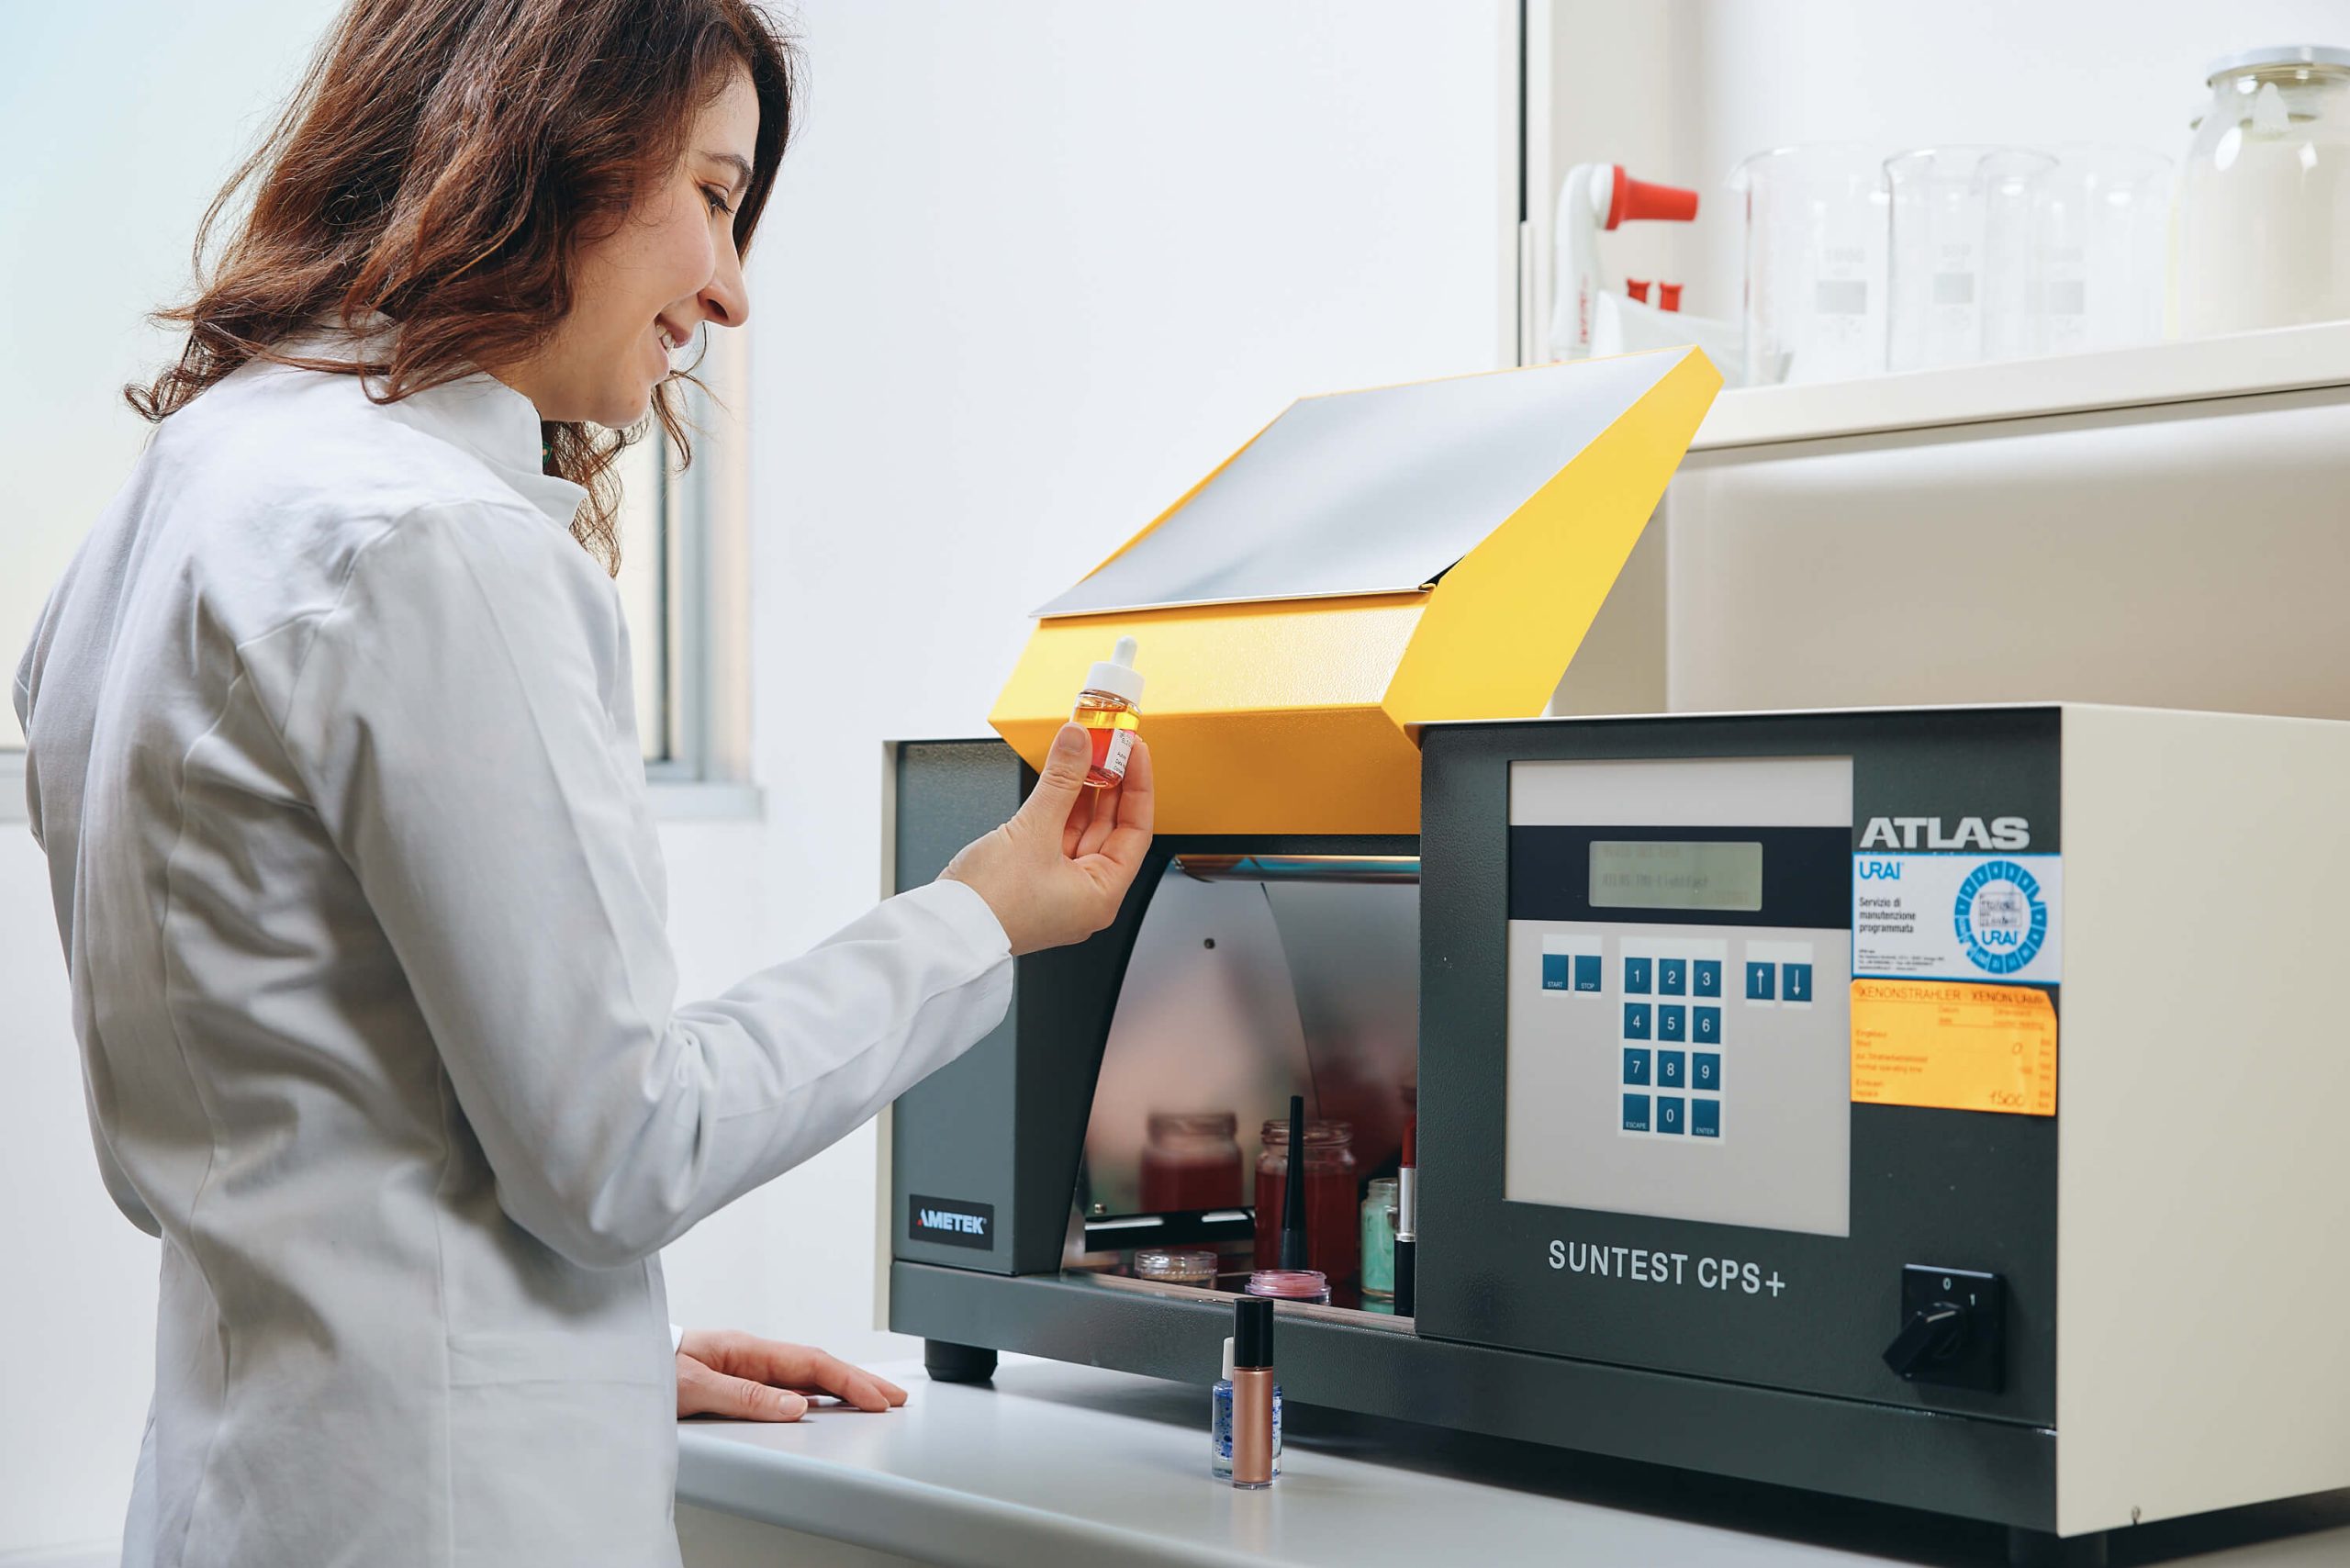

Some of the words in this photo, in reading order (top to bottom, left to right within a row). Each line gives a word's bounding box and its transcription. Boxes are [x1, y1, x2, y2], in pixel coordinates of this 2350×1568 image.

[1859, 816, 2031, 850] ATLAS
[1859, 860, 1900, 880] URAI
[1859, 897, 1891, 908] Servizio
[1893, 897, 1901, 908] di
[1859, 910, 1916, 921] manutenzione
[1859, 923, 1914, 935] programmata
[1981, 930, 2018, 946] URAI
[1547, 980, 1563, 989] START
[1581, 981, 1595, 990] STOP
[1634, 969, 1639, 982] 1
[1669, 970, 1676, 984] 2
[1704, 971, 1711, 986] 3
[1634, 1015, 1640, 1028] 4
[1668, 1016, 1675, 1030] 5
[1703, 1018, 1710, 1032] 6
[1634, 1060, 1640, 1073] 7
[1667, 1062, 1674, 1077] 8
[1703, 1065, 1710, 1079] 9
[1626, 1121, 1647, 1130] ESCAPE
[1667, 1109, 1674, 1123] 0
[1695, 1126, 1715, 1136] ENTER
[917, 1208, 984, 1235] AMETEK
[1549, 1239, 1688, 1285] SUNTEST
[1697, 1257, 1785, 1298] CPS+
[1942, 1277, 1952, 1291] 0
